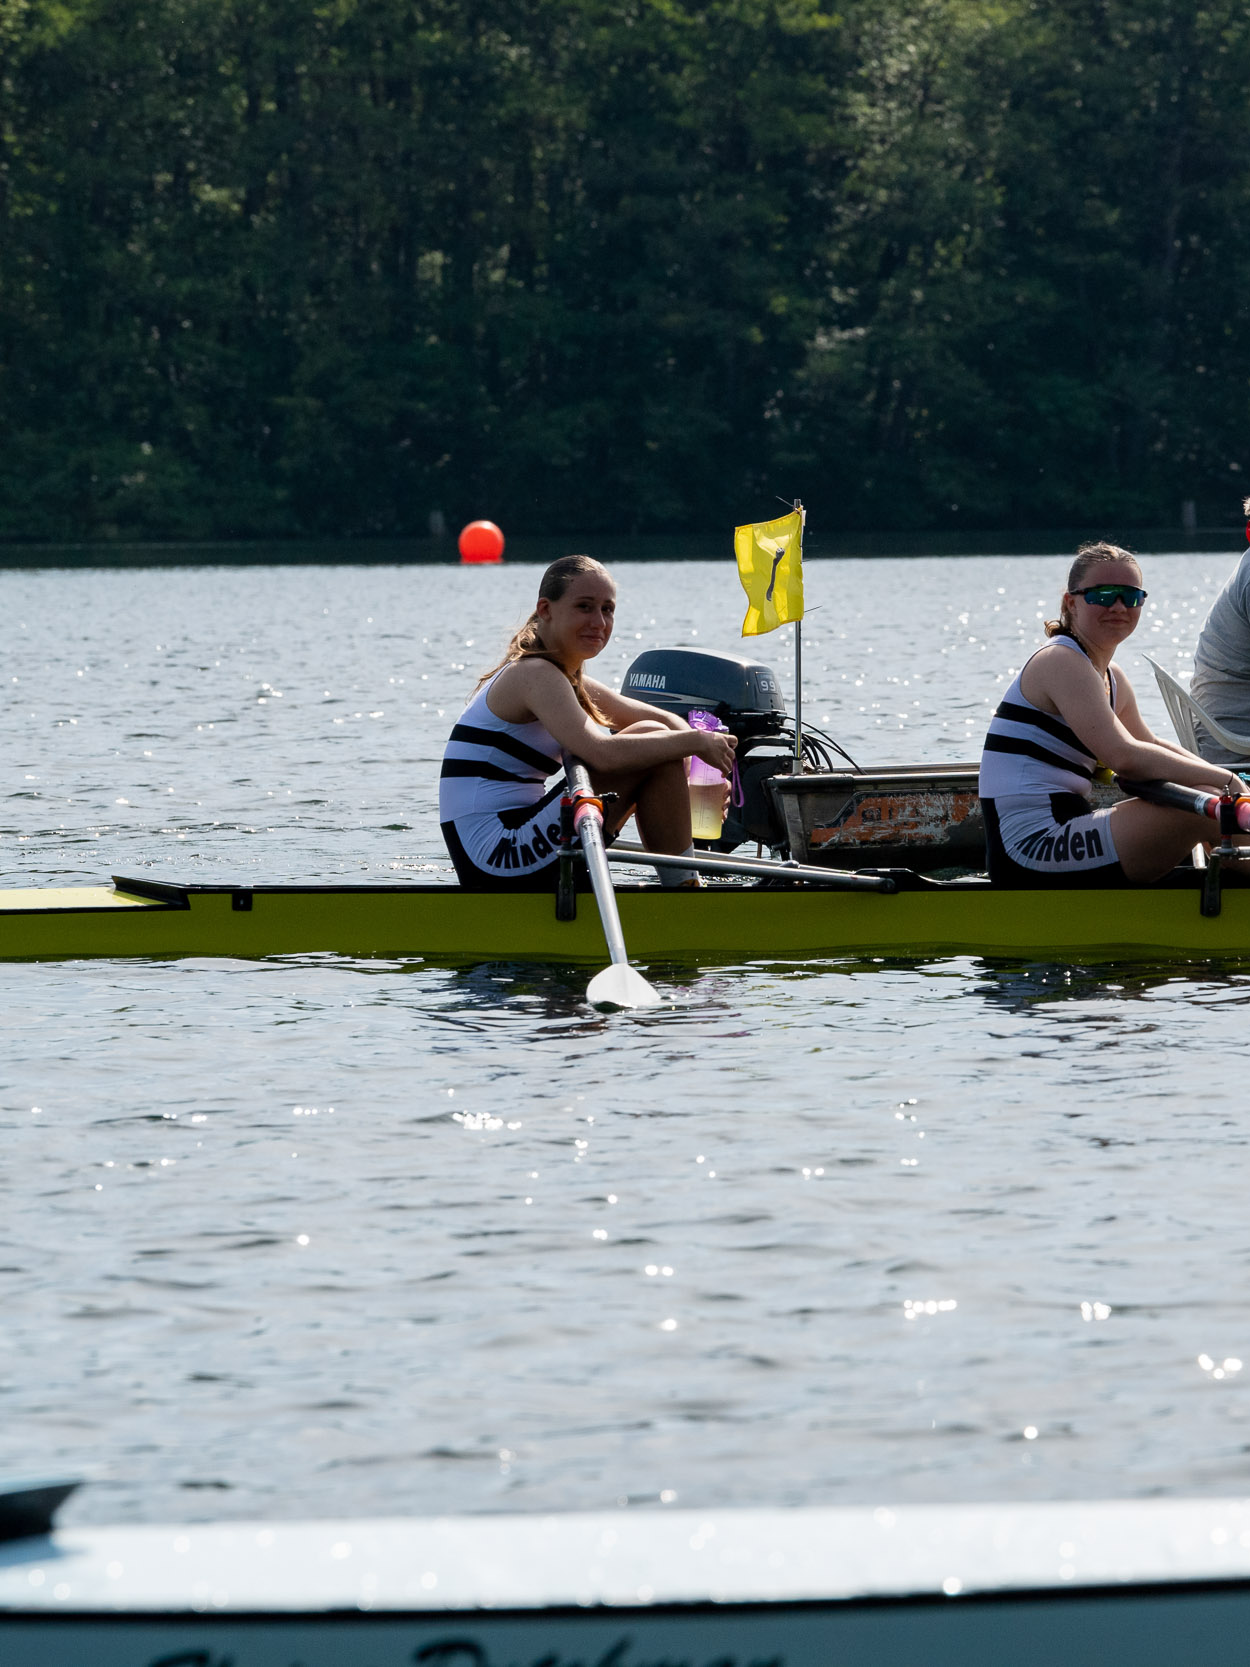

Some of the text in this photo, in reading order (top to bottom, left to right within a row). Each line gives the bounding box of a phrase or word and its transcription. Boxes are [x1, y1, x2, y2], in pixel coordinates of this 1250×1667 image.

[629, 673, 666, 690] YAMAHA
[486, 821, 562, 870] Minde
[1014, 823, 1104, 863] Minden
